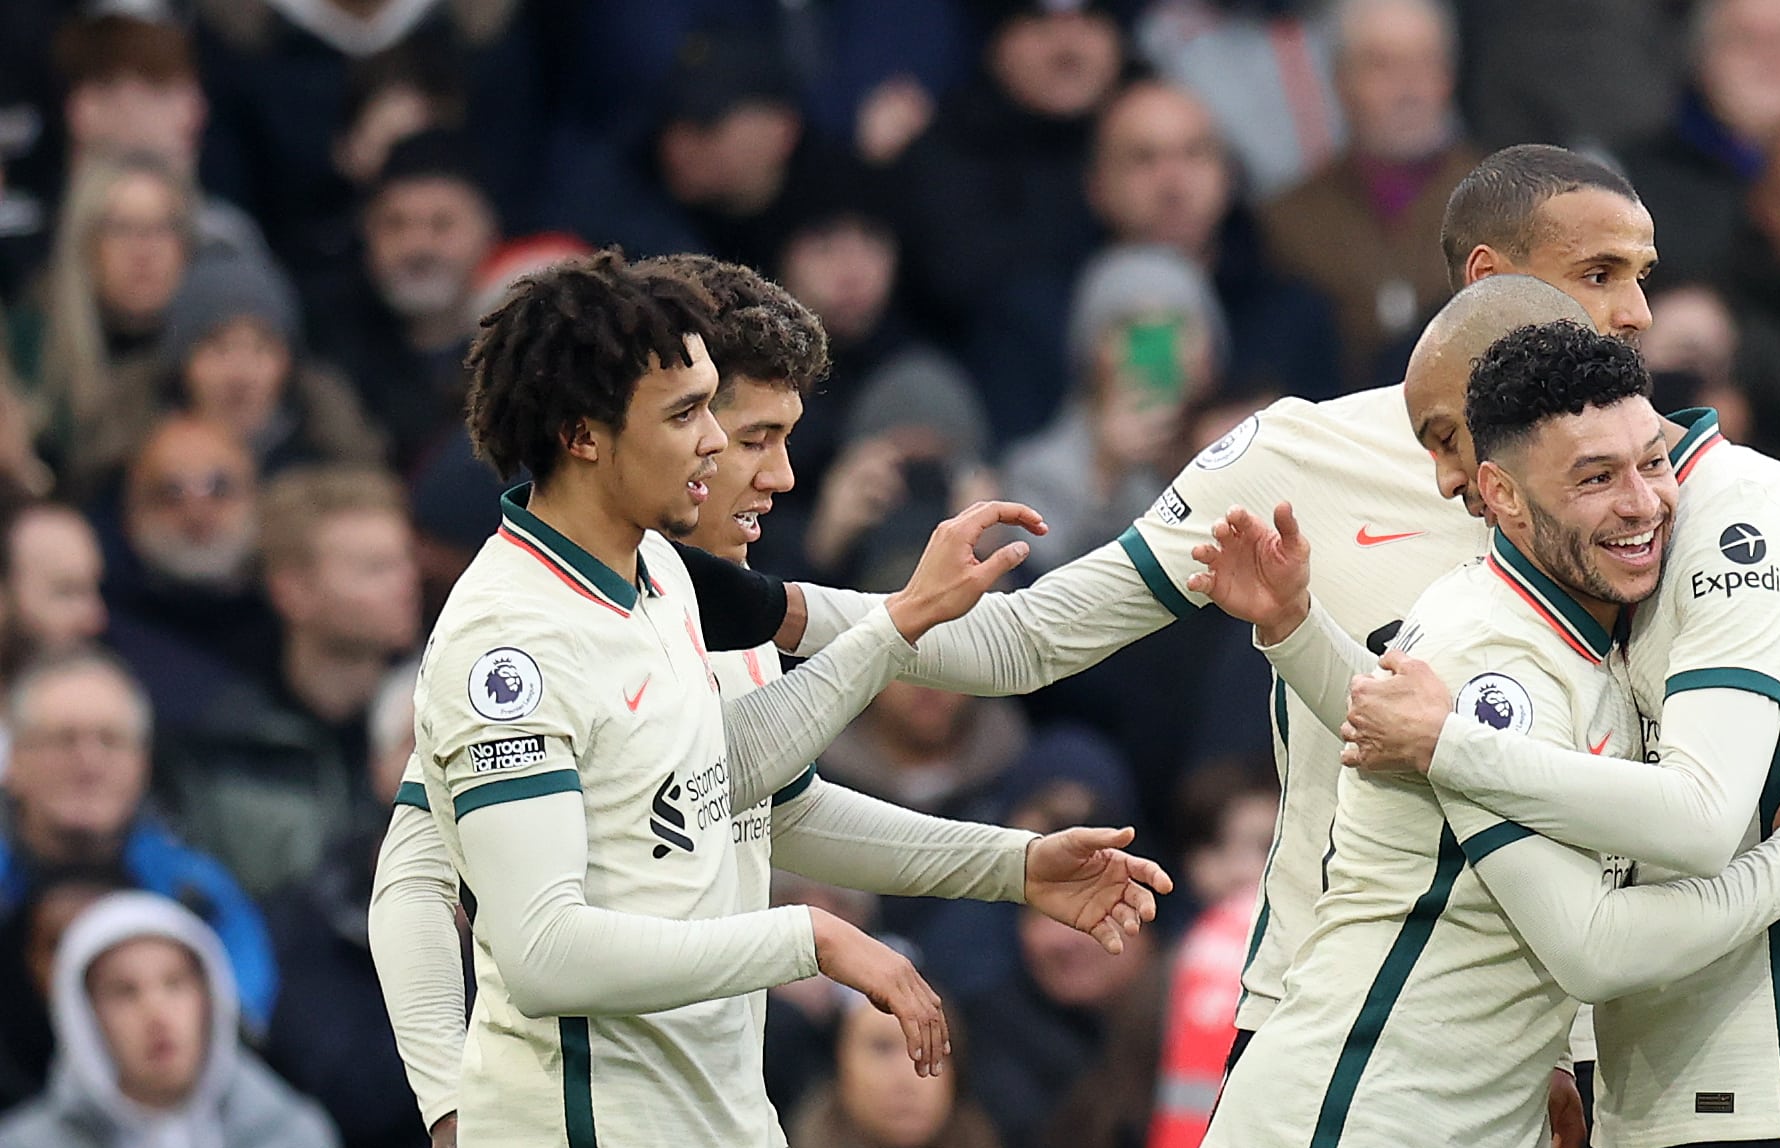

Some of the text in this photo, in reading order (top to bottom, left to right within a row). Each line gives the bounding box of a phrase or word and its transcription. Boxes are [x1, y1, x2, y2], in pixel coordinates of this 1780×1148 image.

[469, 738, 539, 761] No room
[473, 751, 546, 773] for racism
